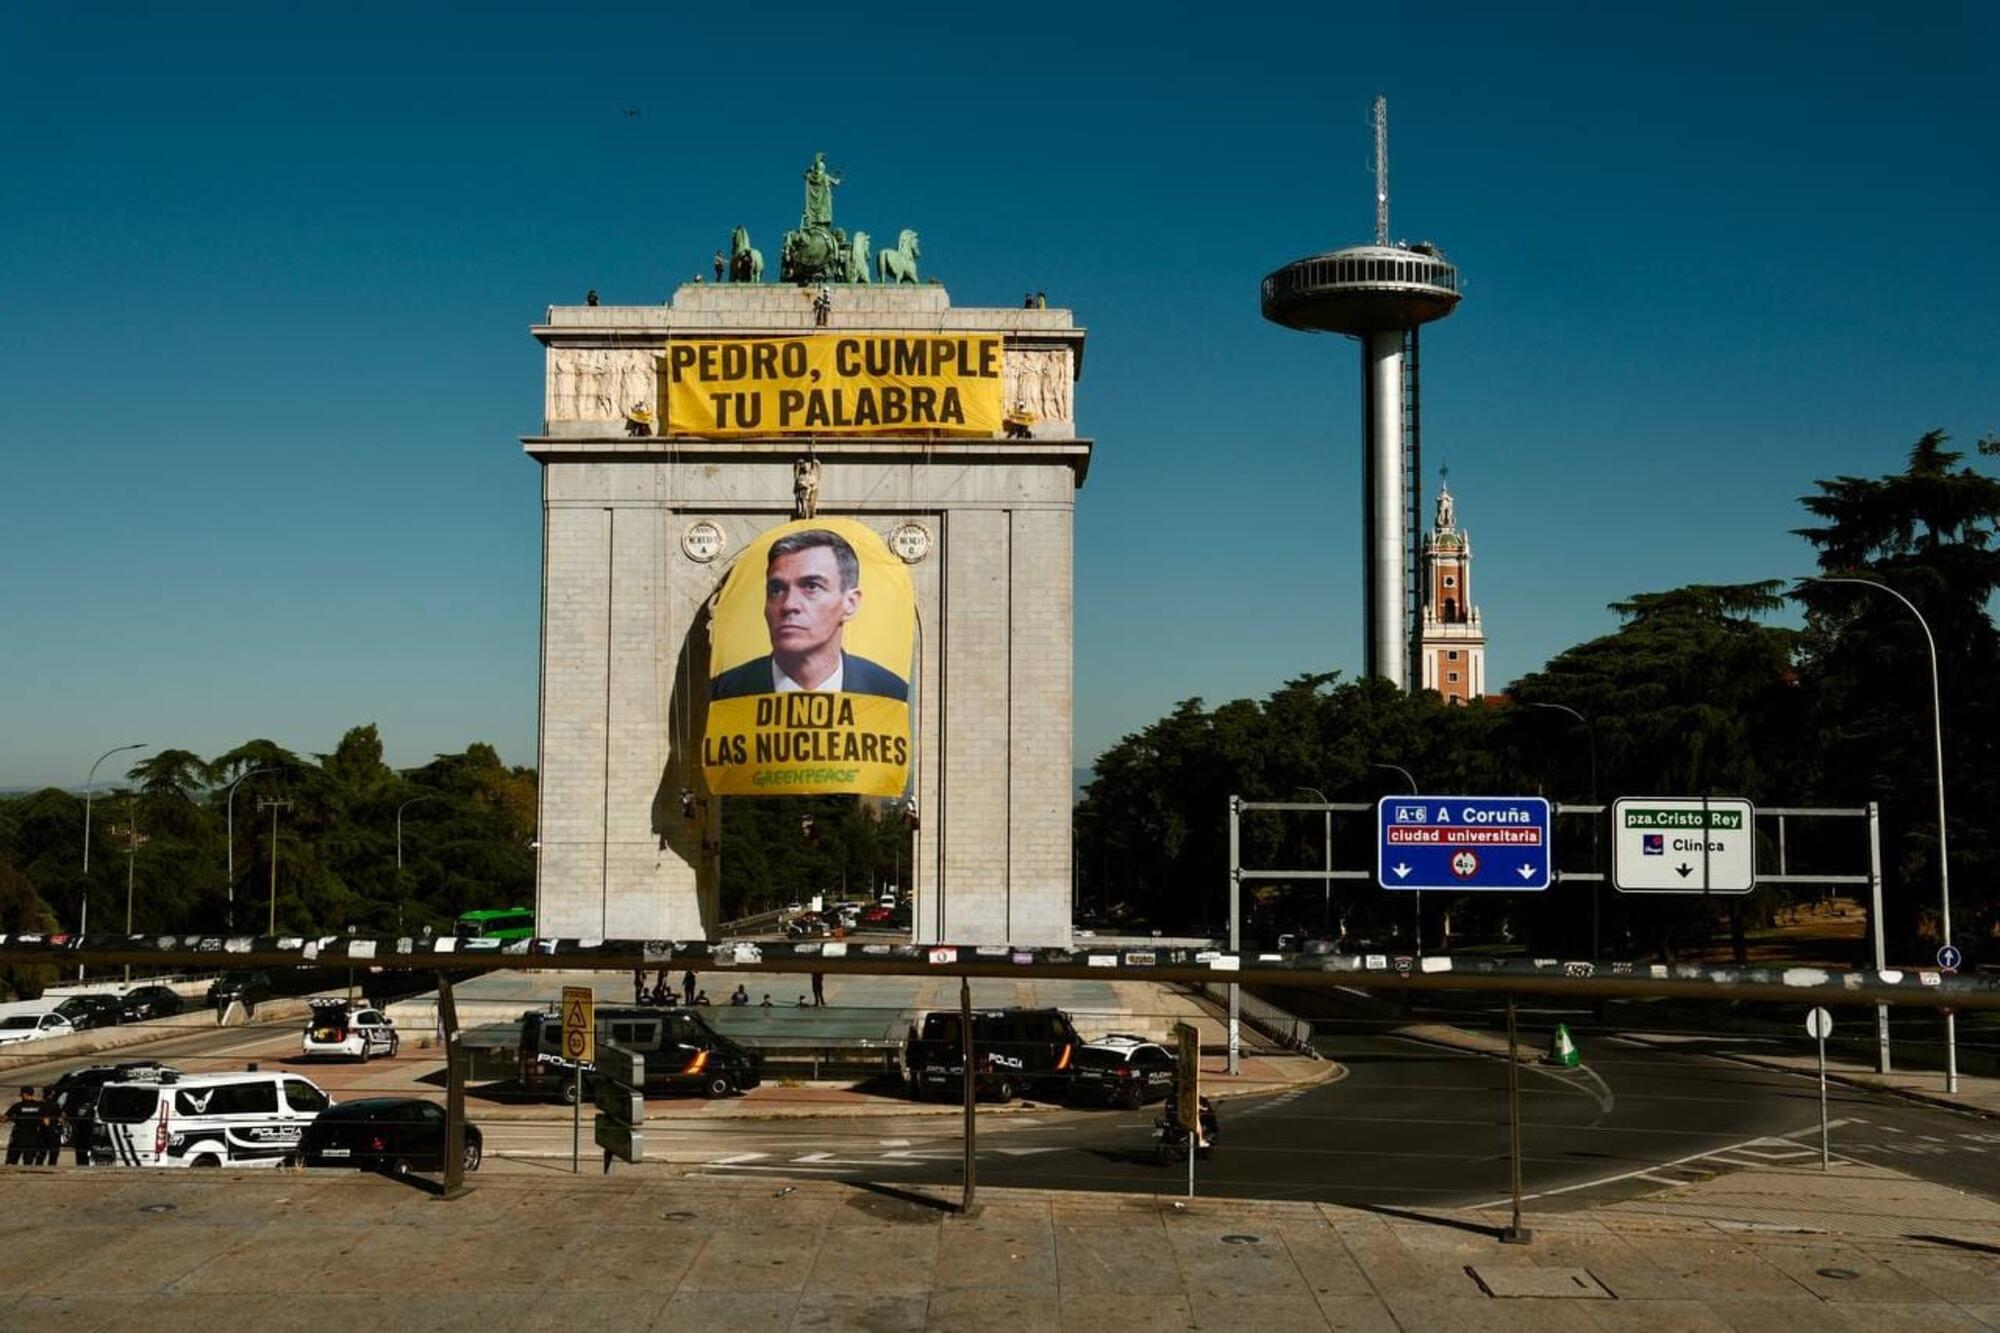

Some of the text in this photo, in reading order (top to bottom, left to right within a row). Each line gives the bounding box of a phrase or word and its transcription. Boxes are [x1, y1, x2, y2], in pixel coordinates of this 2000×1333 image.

[672, 338, 1000, 384] PEDRO, CUMPLE
[710, 386, 965, 429] TU PALABRA
[756, 695, 855, 727] DI NO A
[704, 731, 907, 767] LAS NUCLEARES
[752, 768, 860, 786] GREENPEACE
[1398, 807, 1531, 823] A-6 A Coruña
[1711, 813, 1740, 828] Rey
[1391, 829, 1538, 843] ciudad universitaria
[988, 1053, 1023, 1069] POLICIA
